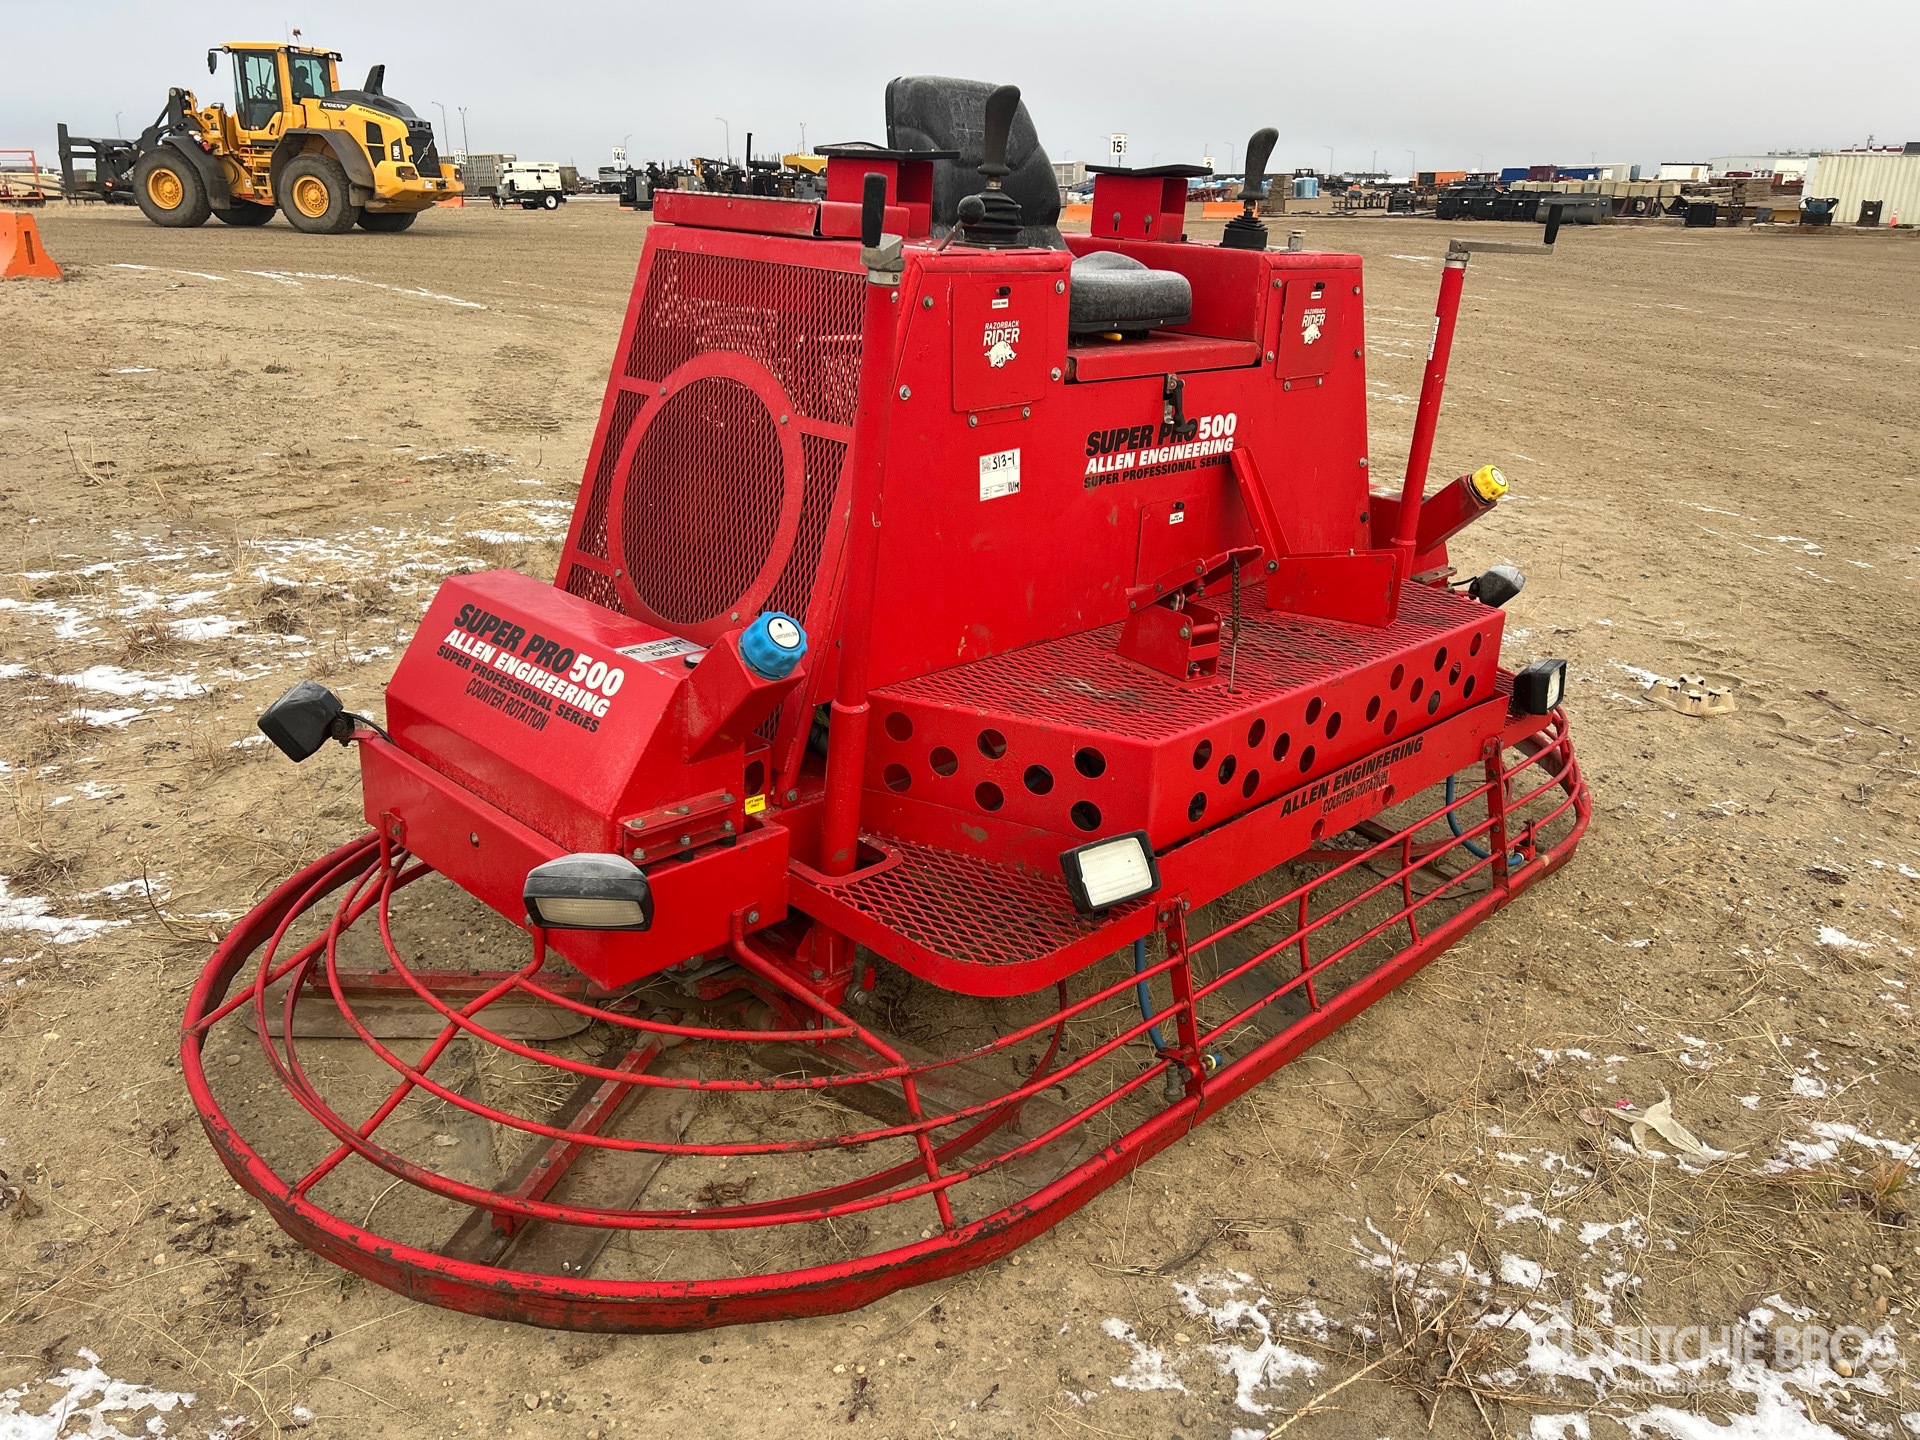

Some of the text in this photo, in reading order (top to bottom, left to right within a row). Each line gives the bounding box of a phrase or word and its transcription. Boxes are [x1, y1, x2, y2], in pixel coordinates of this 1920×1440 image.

[1112, 141, 1123, 153] 15
[983, 328, 1020, 347] RIDER
[985, 320, 1020, 331] RAZORBACK
[1301, 313, 1326, 328] RIDER
[1085, 412, 1238, 457] SUPER PRO 500
[1084, 436, 1235, 475] ALLEN ENGINEERING
[1083, 472, 1119, 489] SUPER
[1122, 460, 1197, 482] PROFESSIONAL
[453, 603, 626, 697] SUPER PRO 500
[622, 638, 686, 656] RETARDANT
[651, 647, 679, 658] ONLY
[436, 645, 600, 733] SUPER PROFESSIONAL SERIES
[443, 628, 611, 718] ALLEN ENGINEERING
[465, 677, 550, 732] COUNTER ROTATION
[1280, 736, 1424, 819] ALLEN ENGINEERING
